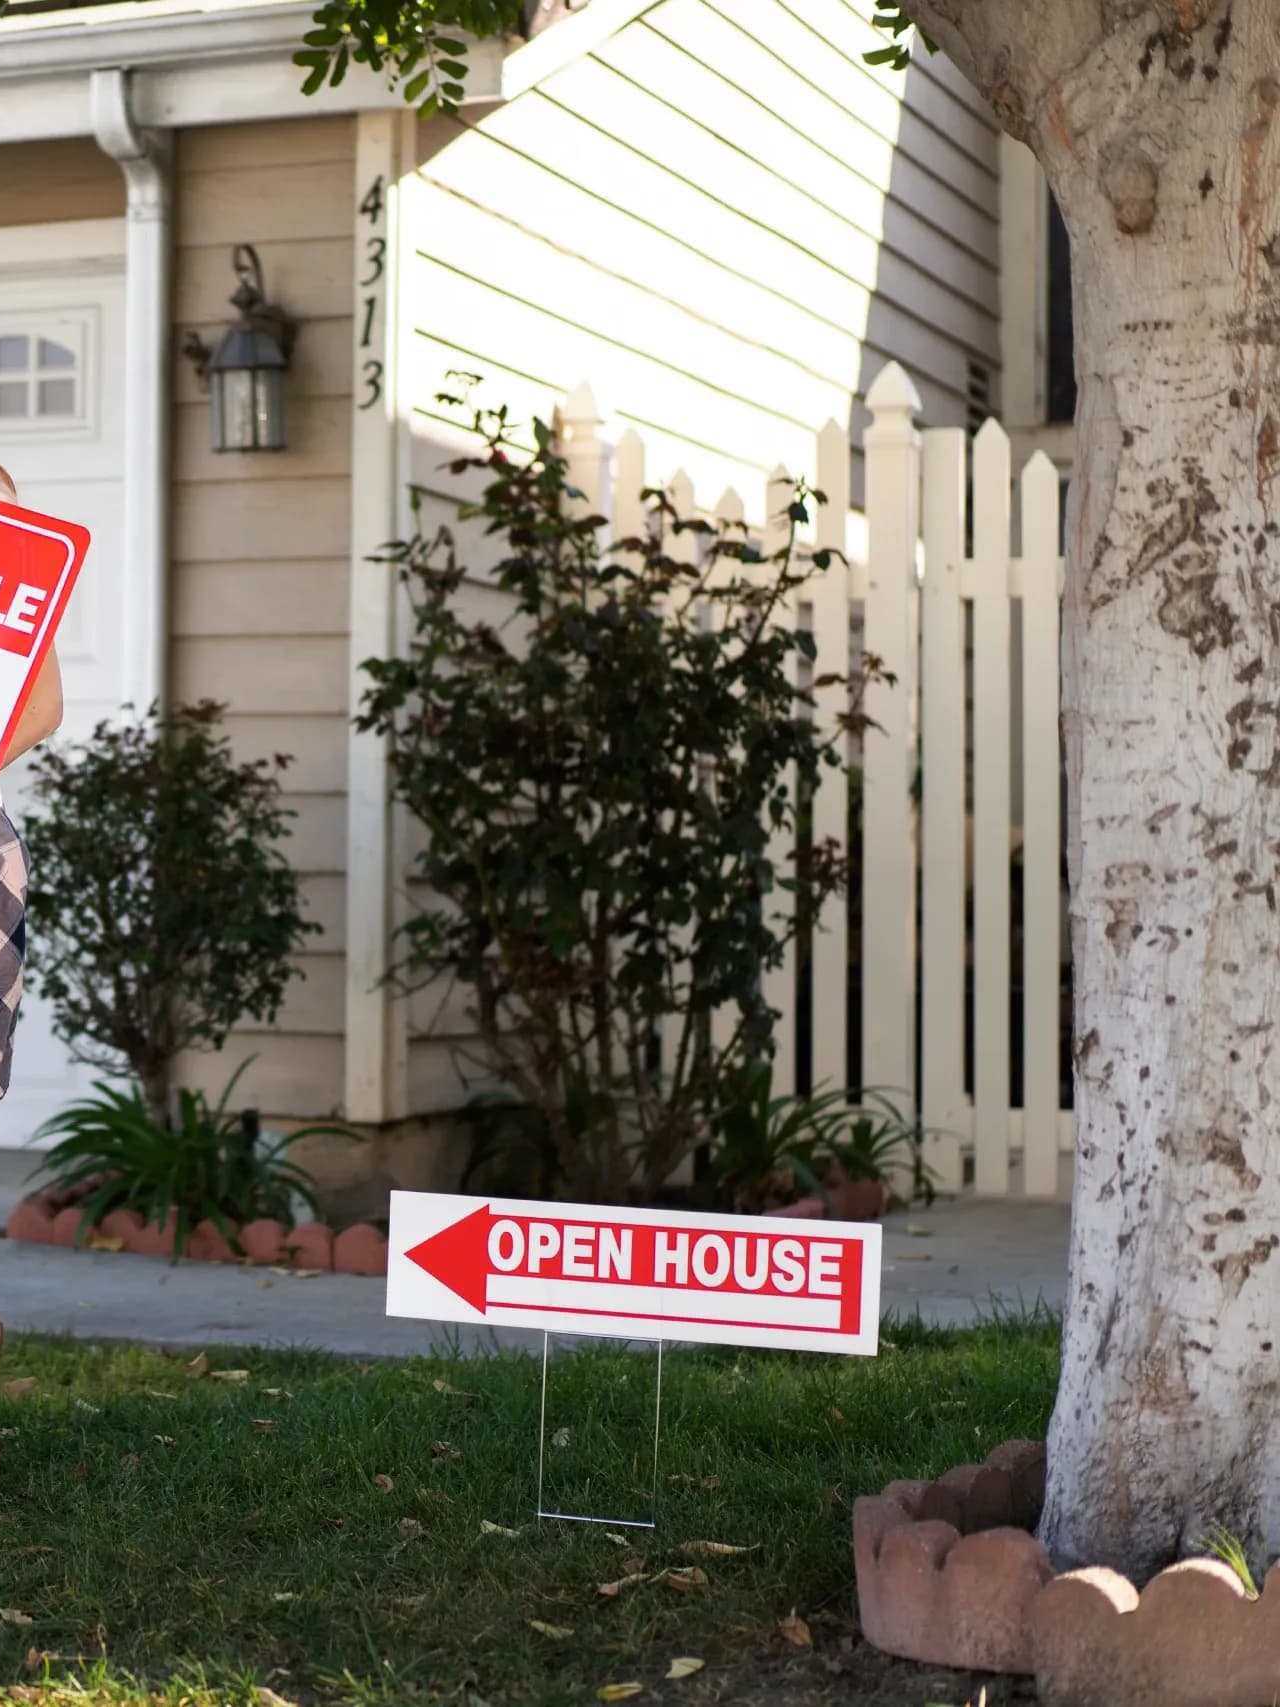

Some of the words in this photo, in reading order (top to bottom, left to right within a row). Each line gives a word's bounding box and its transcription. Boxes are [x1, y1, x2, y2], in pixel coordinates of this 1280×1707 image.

[358, 174, 387, 411] 4313
[486, 1218, 633, 1281] OPEN
[654, 1231, 843, 1296] HOUSE
